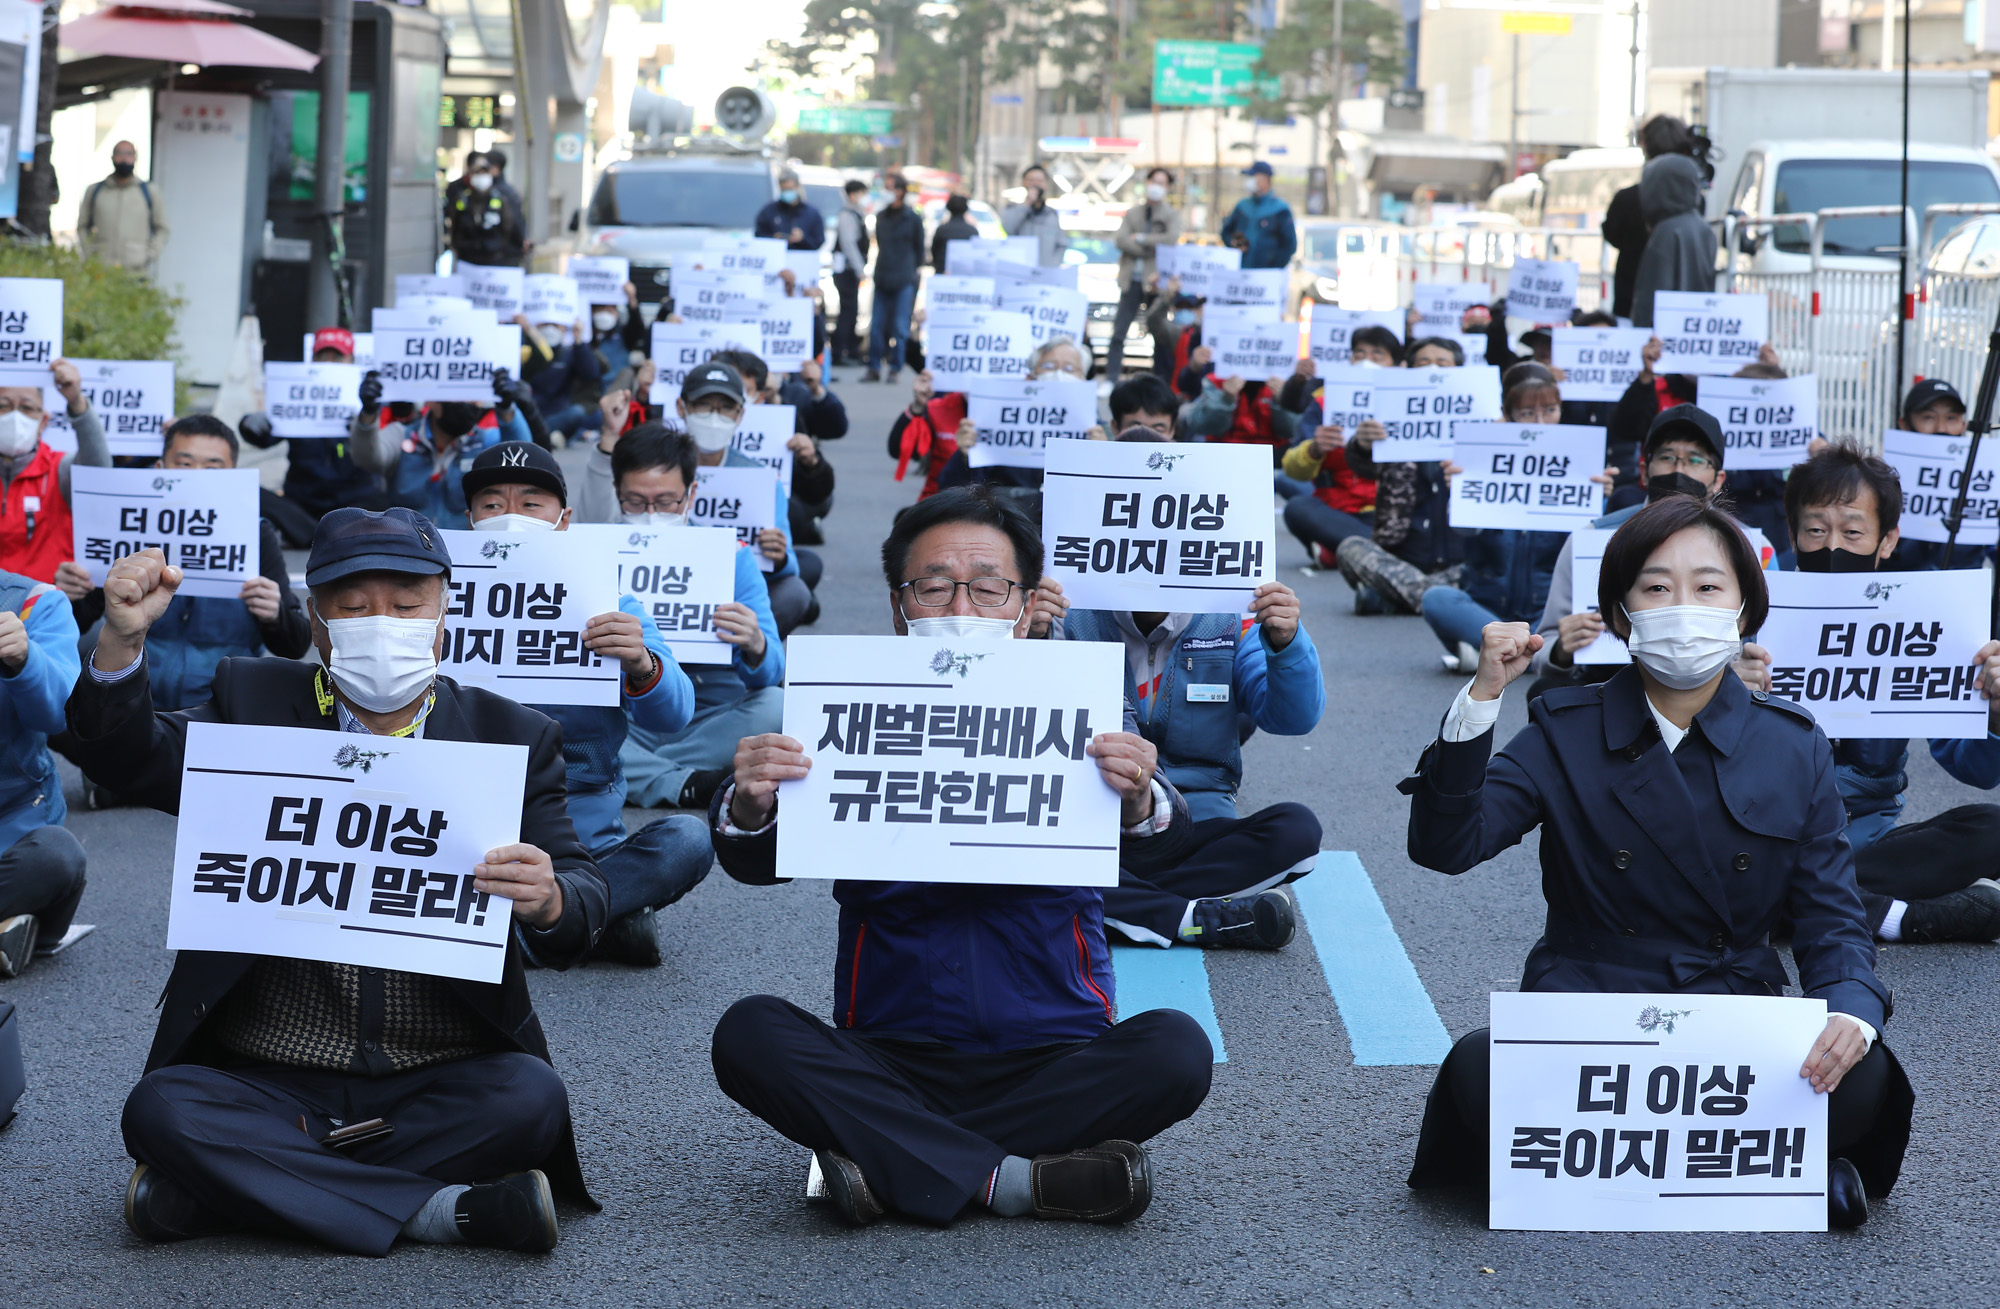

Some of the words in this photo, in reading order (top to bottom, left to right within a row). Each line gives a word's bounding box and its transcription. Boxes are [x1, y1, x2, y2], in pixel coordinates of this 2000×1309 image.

[1330, 328, 1346, 344] 더
[1682, 317, 1700, 334] 더
[1707, 318, 1742, 334] 이상
[405, 337, 424, 357] 더
[432, 338, 473, 357] 이상
[953, 334, 969, 350] 더
[976, 335, 1009, 351] 이상
[1239, 338, 1251, 351] 더
[1661, 336, 1712, 356] 죽이지
[680, 348, 696, 364] 더
[932, 356, 982, 374] 죽이지
[1578, 349, 1593, 364] 더
[1598, 350, 1630, 365] 이상
[379, 362, 440, 381] 죽이지
[102, 389, 144, 409] 이상
[290, 386, 305, 400] 더
[310, 386, 341, 402] 이상
[1353, 391, 1369, 408] 더
[1407, 396, 1426, 415] 더
[1433, 395, 1473, 415] 이상
[1000, 407, 1019, 424] 더
[1026, 407, 1067, 426] 이상
[1728, 406, 1747, 425] 더
[1755, 406, 1794, 424] 이상
[1386, 421, 1442, 441] 죽이지
[1725, 430, 1762, 449] 이지
[1770, 427, 1812, 449] 말라!
[1491, 454, 1514, 476] 더
[1523, 455, 1570, 477] 이상
[1918, 466, 1941, 488] 더
[1461, 480, 1531, 505] 죽이지
[1539, 485, 1593, 508] 말라!
[694, 497, 741, 520] 이상
[1101, 493, 1141, 529] 더
[1151, 494, 1229, 531] 이상
[120, 507, 148, 534] 더
[158, 509, 217, 536] 이상
[180, 545, 246, 573] 말라!
[1053, 535, 1168, 575] 죽이지
[1179, 540, 1264, 578] 말라!
[631, 565, 693, 595] 이상
[487, 583, 567, 620] 이상
[441, 628, 505, 667] 이지
[1817, 623, 1858, 657] 더
[1866, 622, 1943, 657] 이상
[1771, 667, 1881, 702] 죽이지
[1890, 666, 1975, 701] 말라!
[817, 703, 1093, 761] 재벌택배사
[829, 770, 1065, 827] 규탄한다!
[265, 796, 323, 846] 더
[335, 802, 448, 857] 이상
[193, 852, 357, 912] 죽이지
[369, 866, 491, 927] 말라!
[1577, 1064, 1631, 1115] 더
[1646, 1065, 1756, 1117] 이상
[1510, 1127, 1670, 1180] 죽이지
[1685, 1127, 1807, 1179] 말라!
